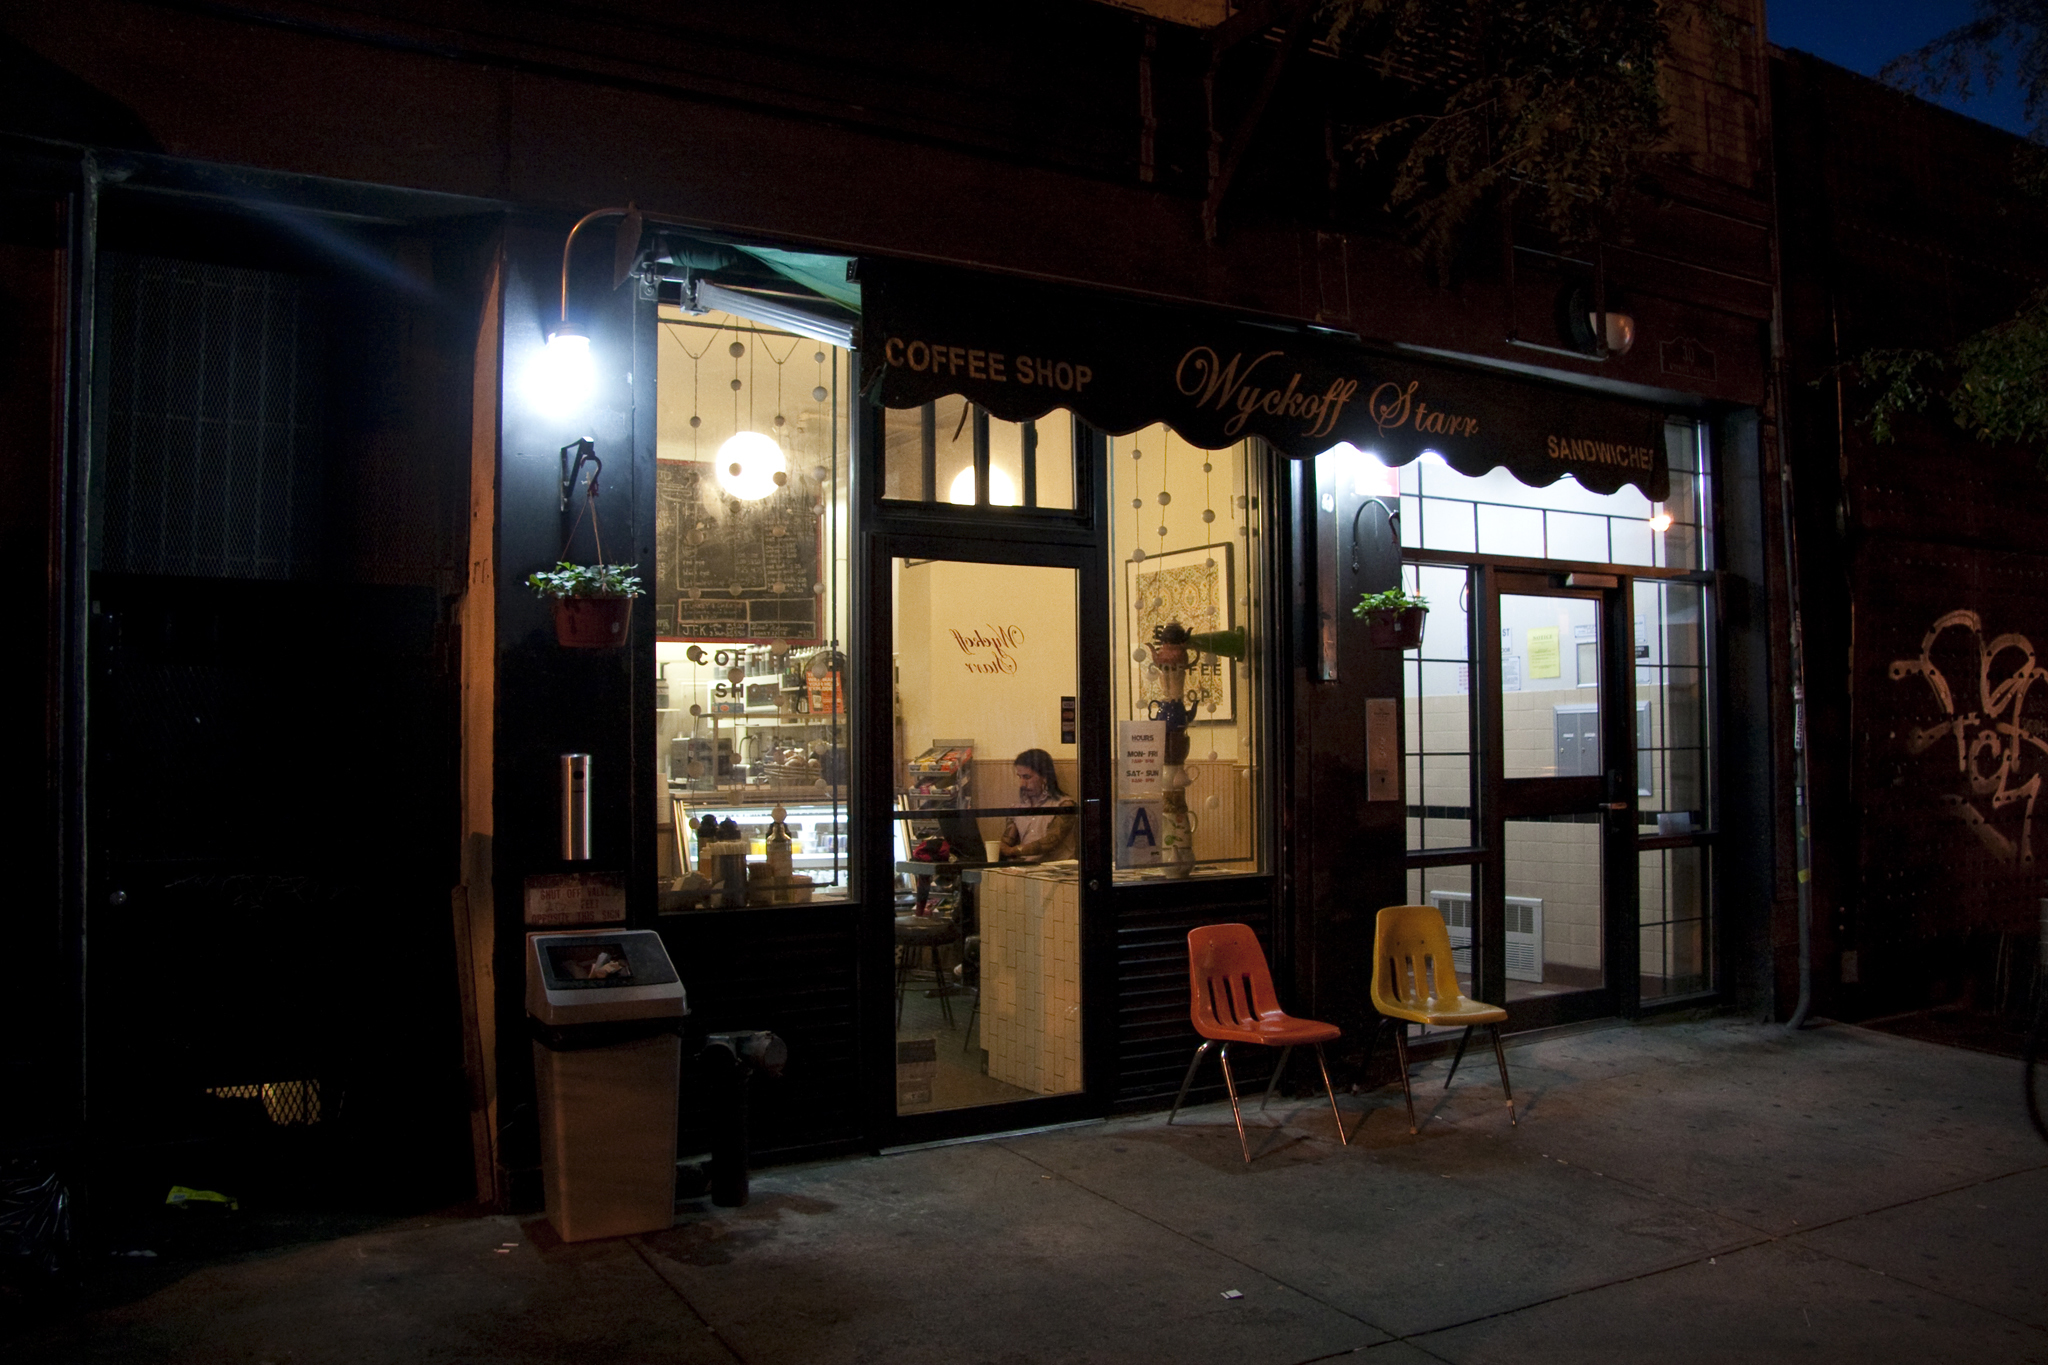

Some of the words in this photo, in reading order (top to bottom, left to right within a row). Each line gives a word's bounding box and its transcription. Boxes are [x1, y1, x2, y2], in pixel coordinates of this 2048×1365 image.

[885, 337, 1007, 382] COFFEE
[1016, 355, 1093, 392] SHOP
[1176, 346, 1358, 438] Wyckoff
[1369, 380, 1479, 438] Starr
[1131, 734, 1154, 742] HOURS
[1126, 807, 1156, 847] A
[540, 890, 560, 900] SHUT
[566, 888, 581, 899] OFF
[531, 912, 571, 924] OPPOSITE
[575, 911, 594, 921] THIS
[602, 909, 620, 920] SIGN
